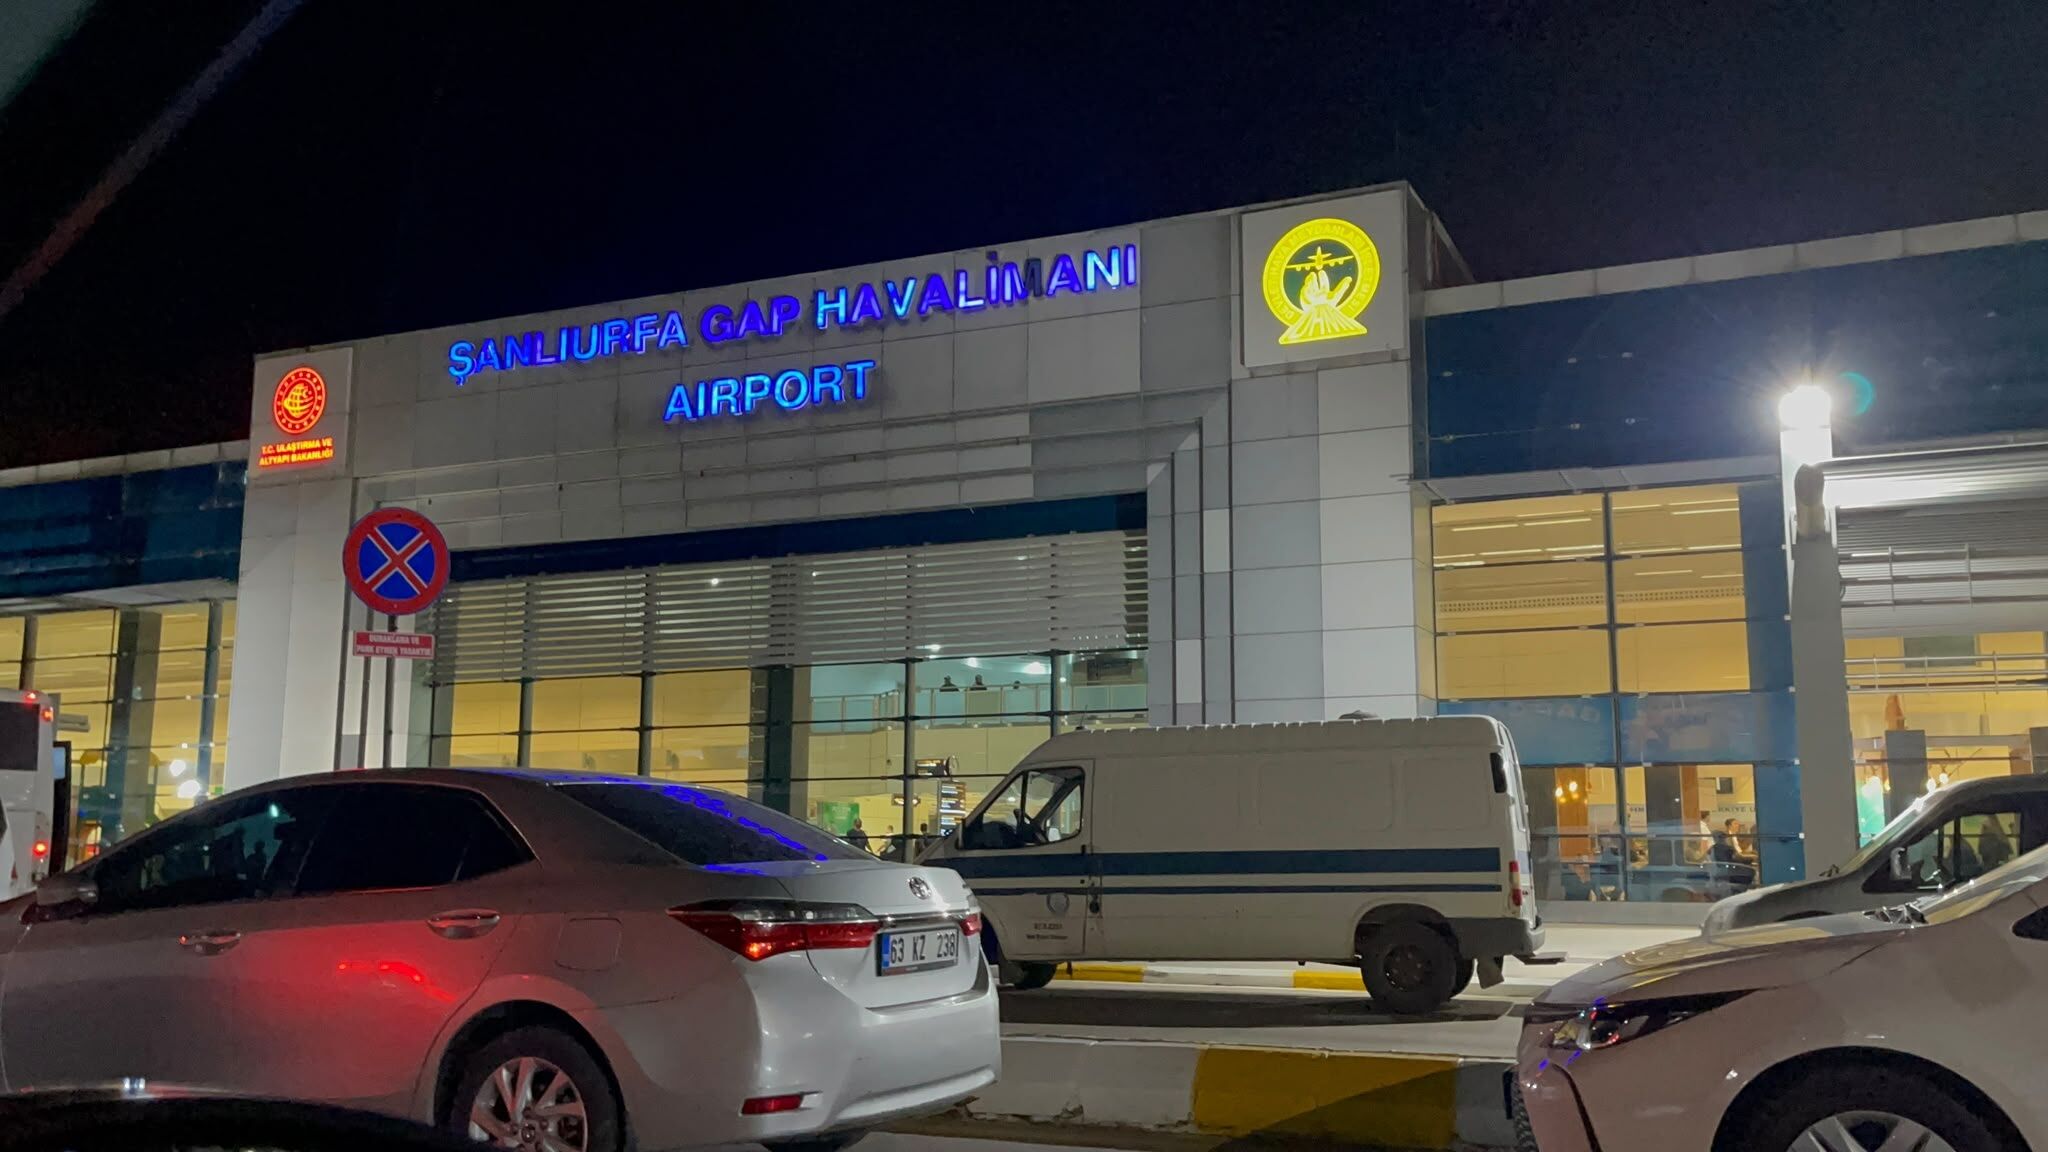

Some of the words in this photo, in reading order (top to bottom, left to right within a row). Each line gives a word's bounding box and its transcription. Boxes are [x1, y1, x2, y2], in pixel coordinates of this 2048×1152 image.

[448, 310, 689, 386] ŞANLIURFA
[700, 295, 801, 344] GAP
[815, 243, 1137, 330] HAVALİMANI
[663, 359, 875, 423] AIRPORT
[259, 455, 290, 466] ALTYAPI
[291, 448, 334, 462] BAKANLIĞI
[276, 439, 320, 453] ULAŞTIRMA
[321, 437, 333, 447] VE
[890, 938, 905, 964] 63
[912, 934, 926, 961] KZ
[936, 933, 956, 958] 238
